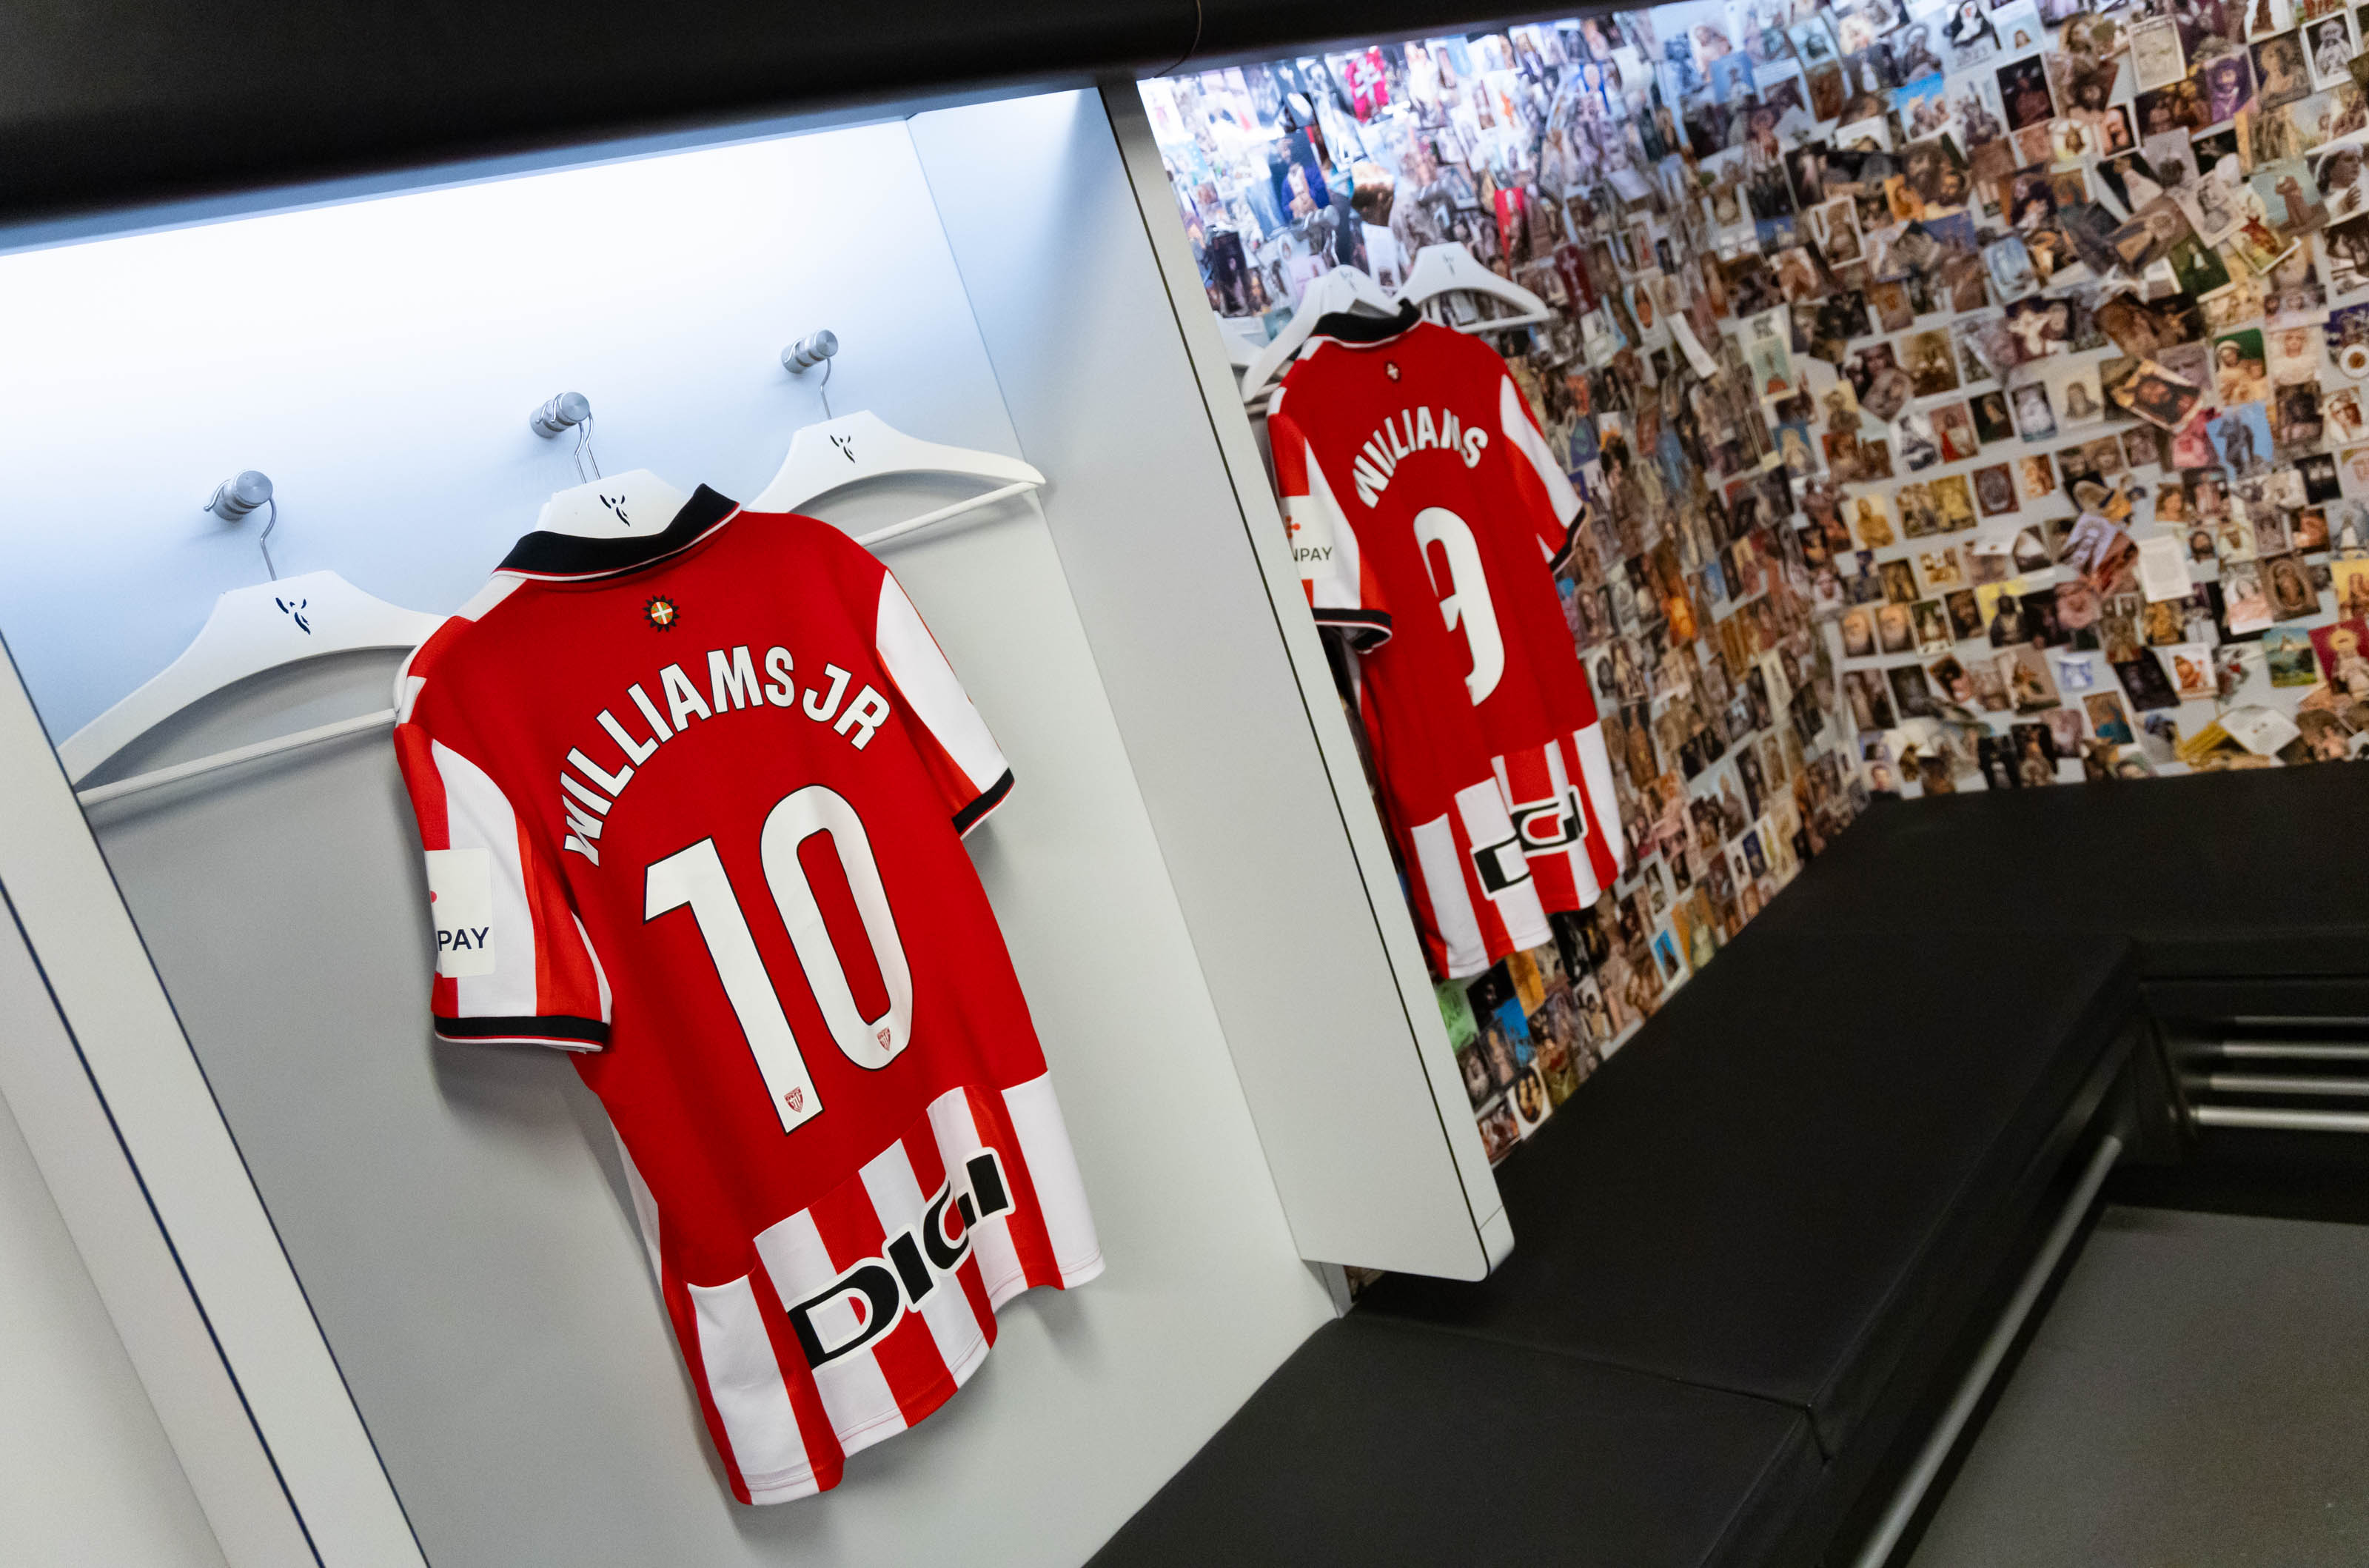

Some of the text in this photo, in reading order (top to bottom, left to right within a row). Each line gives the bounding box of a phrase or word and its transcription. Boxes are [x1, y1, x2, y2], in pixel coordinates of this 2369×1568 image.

[560, 645, 891, 867] WILLIAMS JR
[437, 926, 489, 951] PAY
[644, 785, 914, 1135] 10
[786, 1152, 1010, 1371] DIGI
